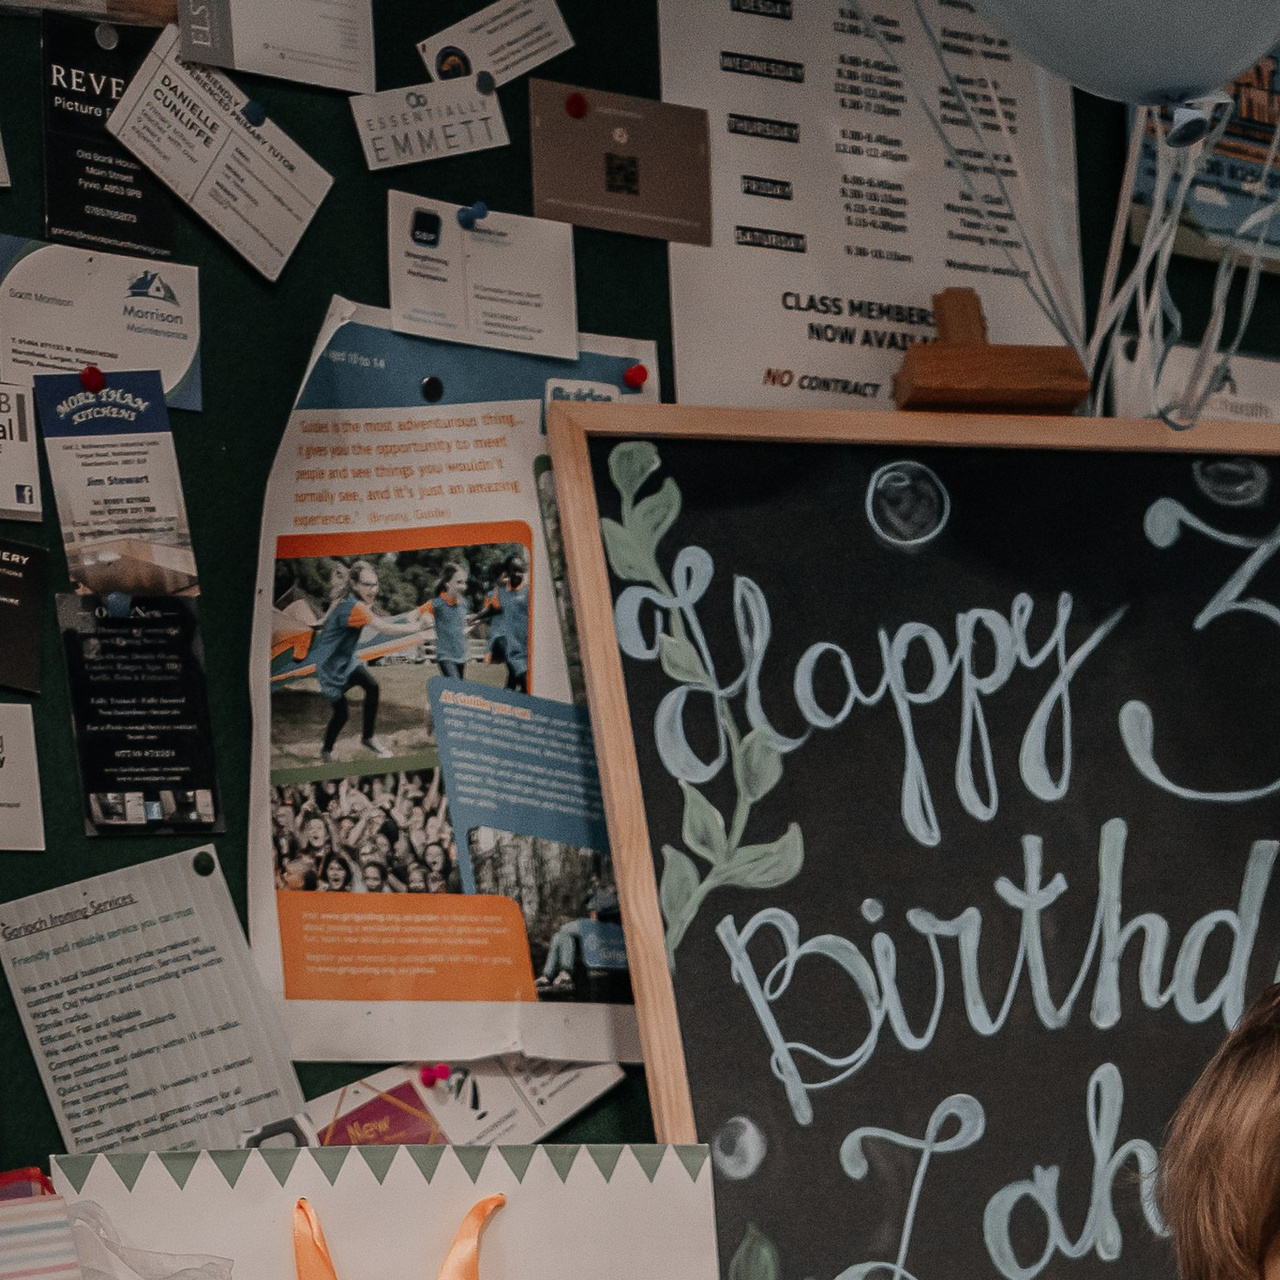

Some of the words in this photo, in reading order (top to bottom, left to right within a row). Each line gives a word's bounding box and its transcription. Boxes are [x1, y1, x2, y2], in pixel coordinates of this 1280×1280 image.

[51, 64, 125, 99] REVE
[54, 96, 102, 117] Picture
[152, 87, 214, 149] CUNLIFFE
[160, 73, 221, 135] DANIELLE
[366, 101, 488, 131] ESSENTIALLY
[371, 117, 495, 163] EMMETT
[267, 143, 297, 174] TUTOR
[123, 304, 184, 325] Morrison
[781, 291, 843, 316] CLASS
[848, 299, 934, 328] MEMBER
[807, 322, 856, 345] NOW
[763, 367, 795, 388] NO
[799, 375, 881, 398] CONTRACT
[107, 475, 151, 487] Stewart
[615, 545, 1129, 848] Happy
[90, 892, 136, 915] Services
